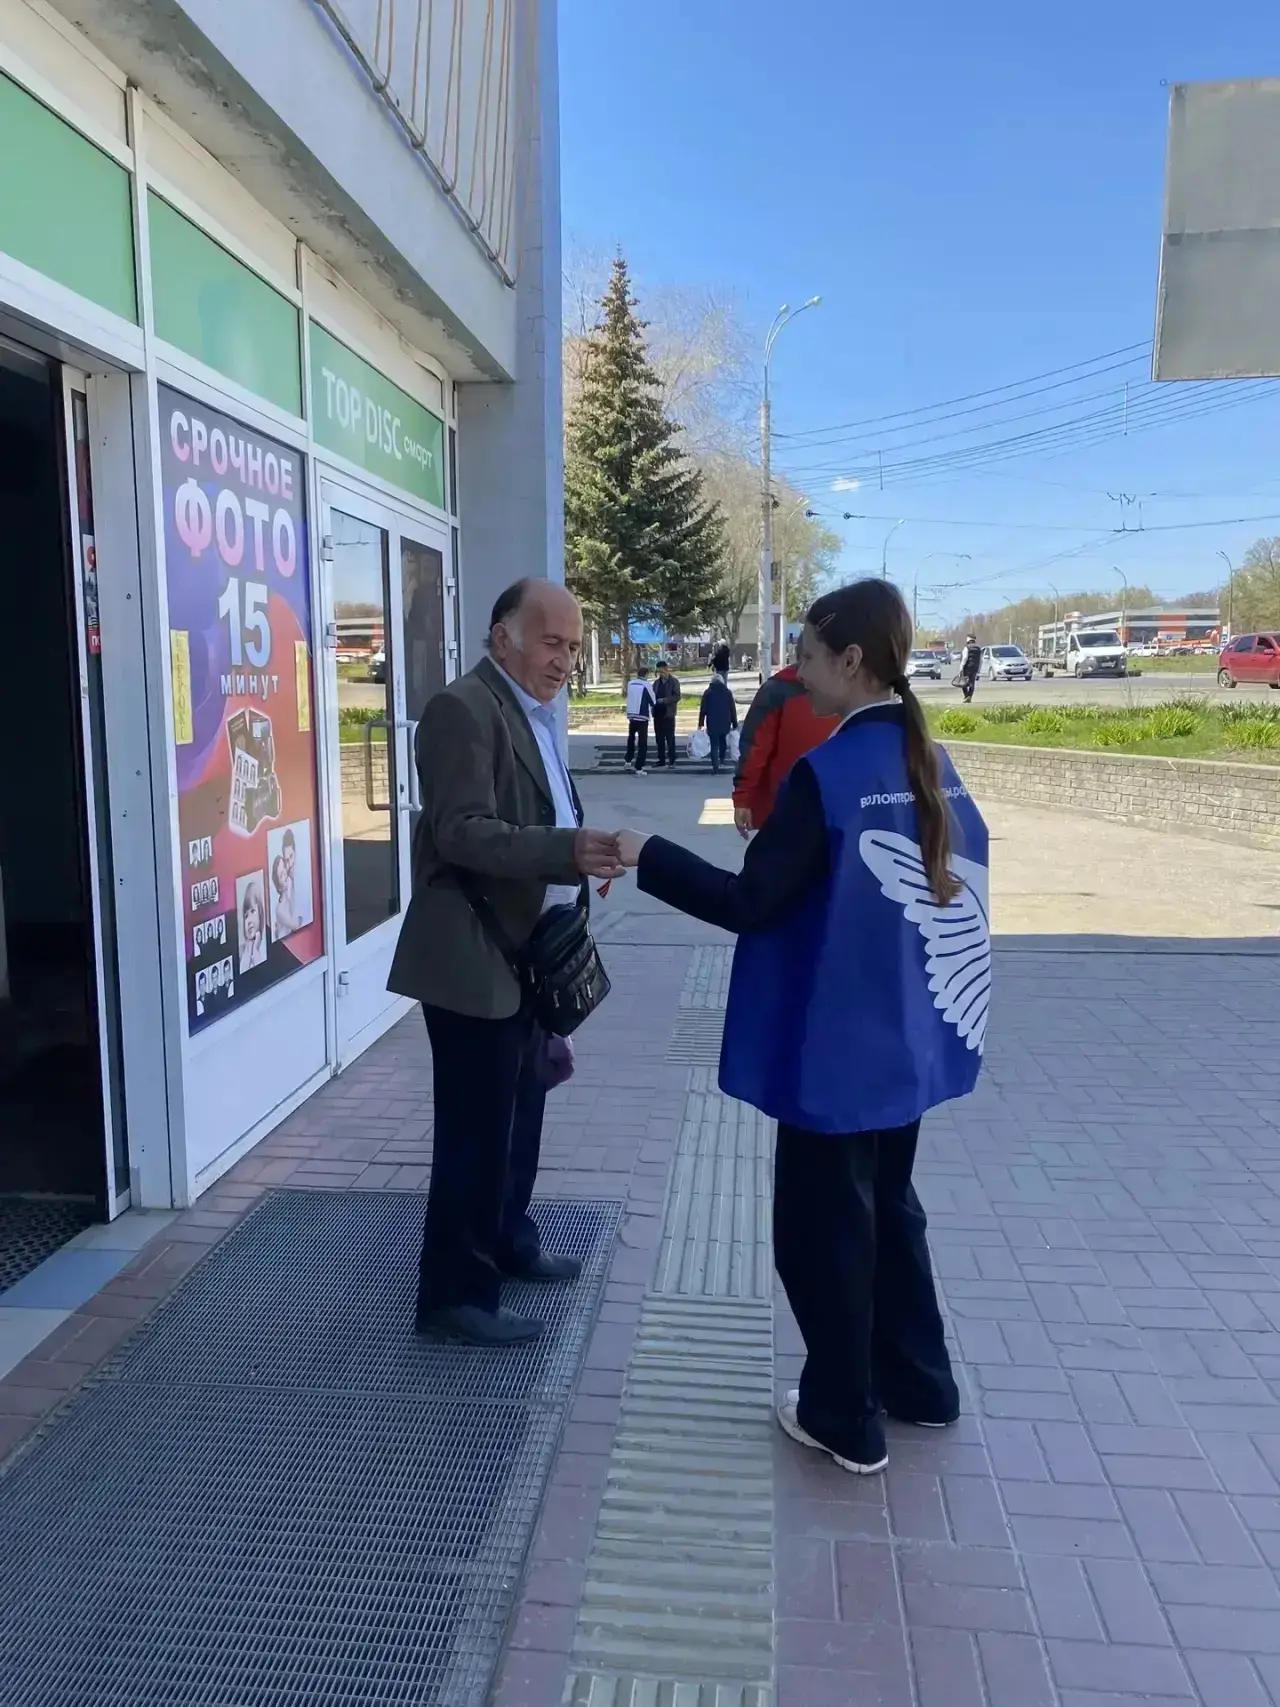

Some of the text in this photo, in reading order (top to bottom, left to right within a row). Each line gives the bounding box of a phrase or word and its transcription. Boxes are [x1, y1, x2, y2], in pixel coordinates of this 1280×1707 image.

[170, 410, 294, 501] СРОЧНОЕ
[321, 366, 433, 471] TOP DISC смарт
[174, 477, 297, 578] ФОТО
[218, 577, 271, 668] 15
[220, 673, 279, 701] минут
